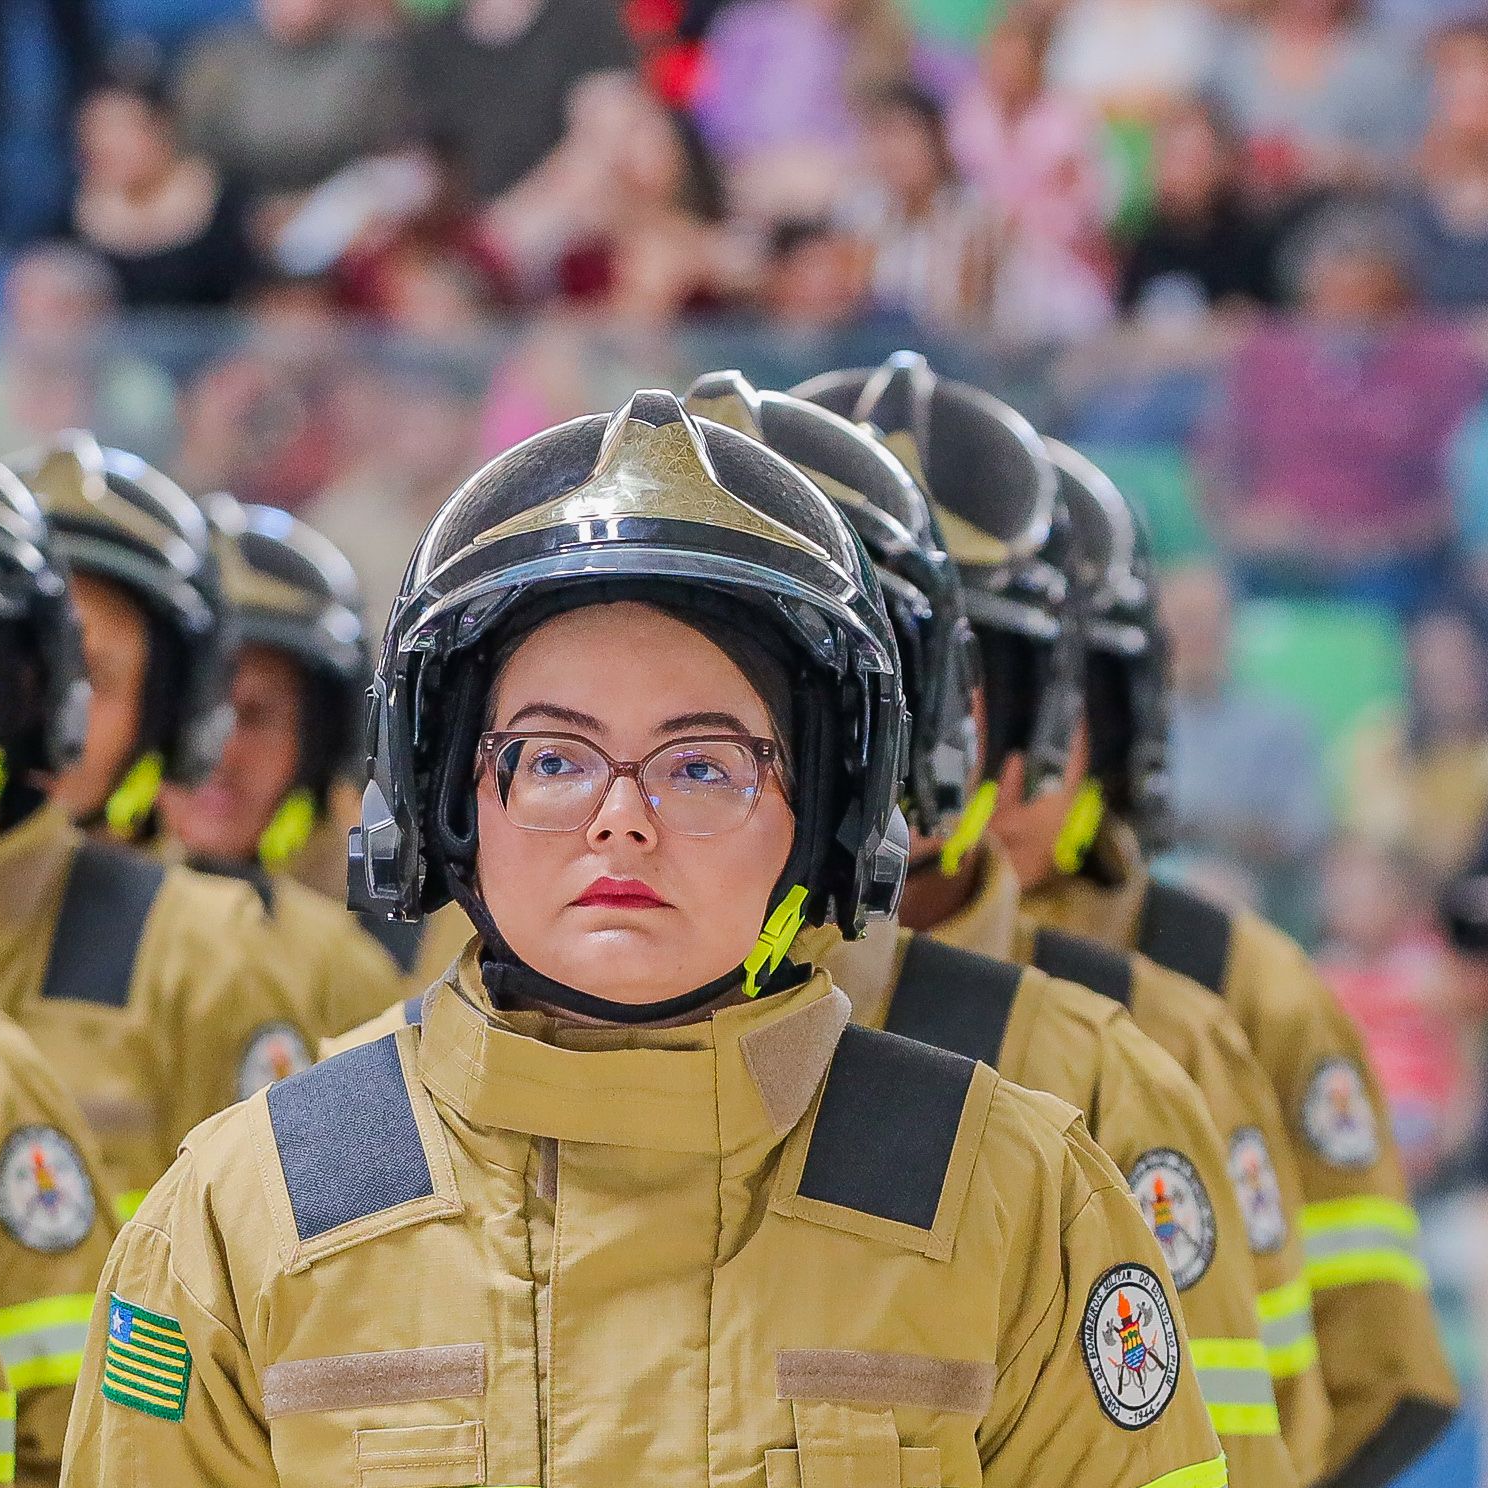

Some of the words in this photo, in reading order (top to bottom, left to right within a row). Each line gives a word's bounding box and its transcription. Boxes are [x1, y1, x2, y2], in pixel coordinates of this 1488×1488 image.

[1084, 1293, 1104, 1361] BOMBEIROS
[1138, 1274, 1151, 1287] DO
[1167, 1331, 1176, 1348] DO
